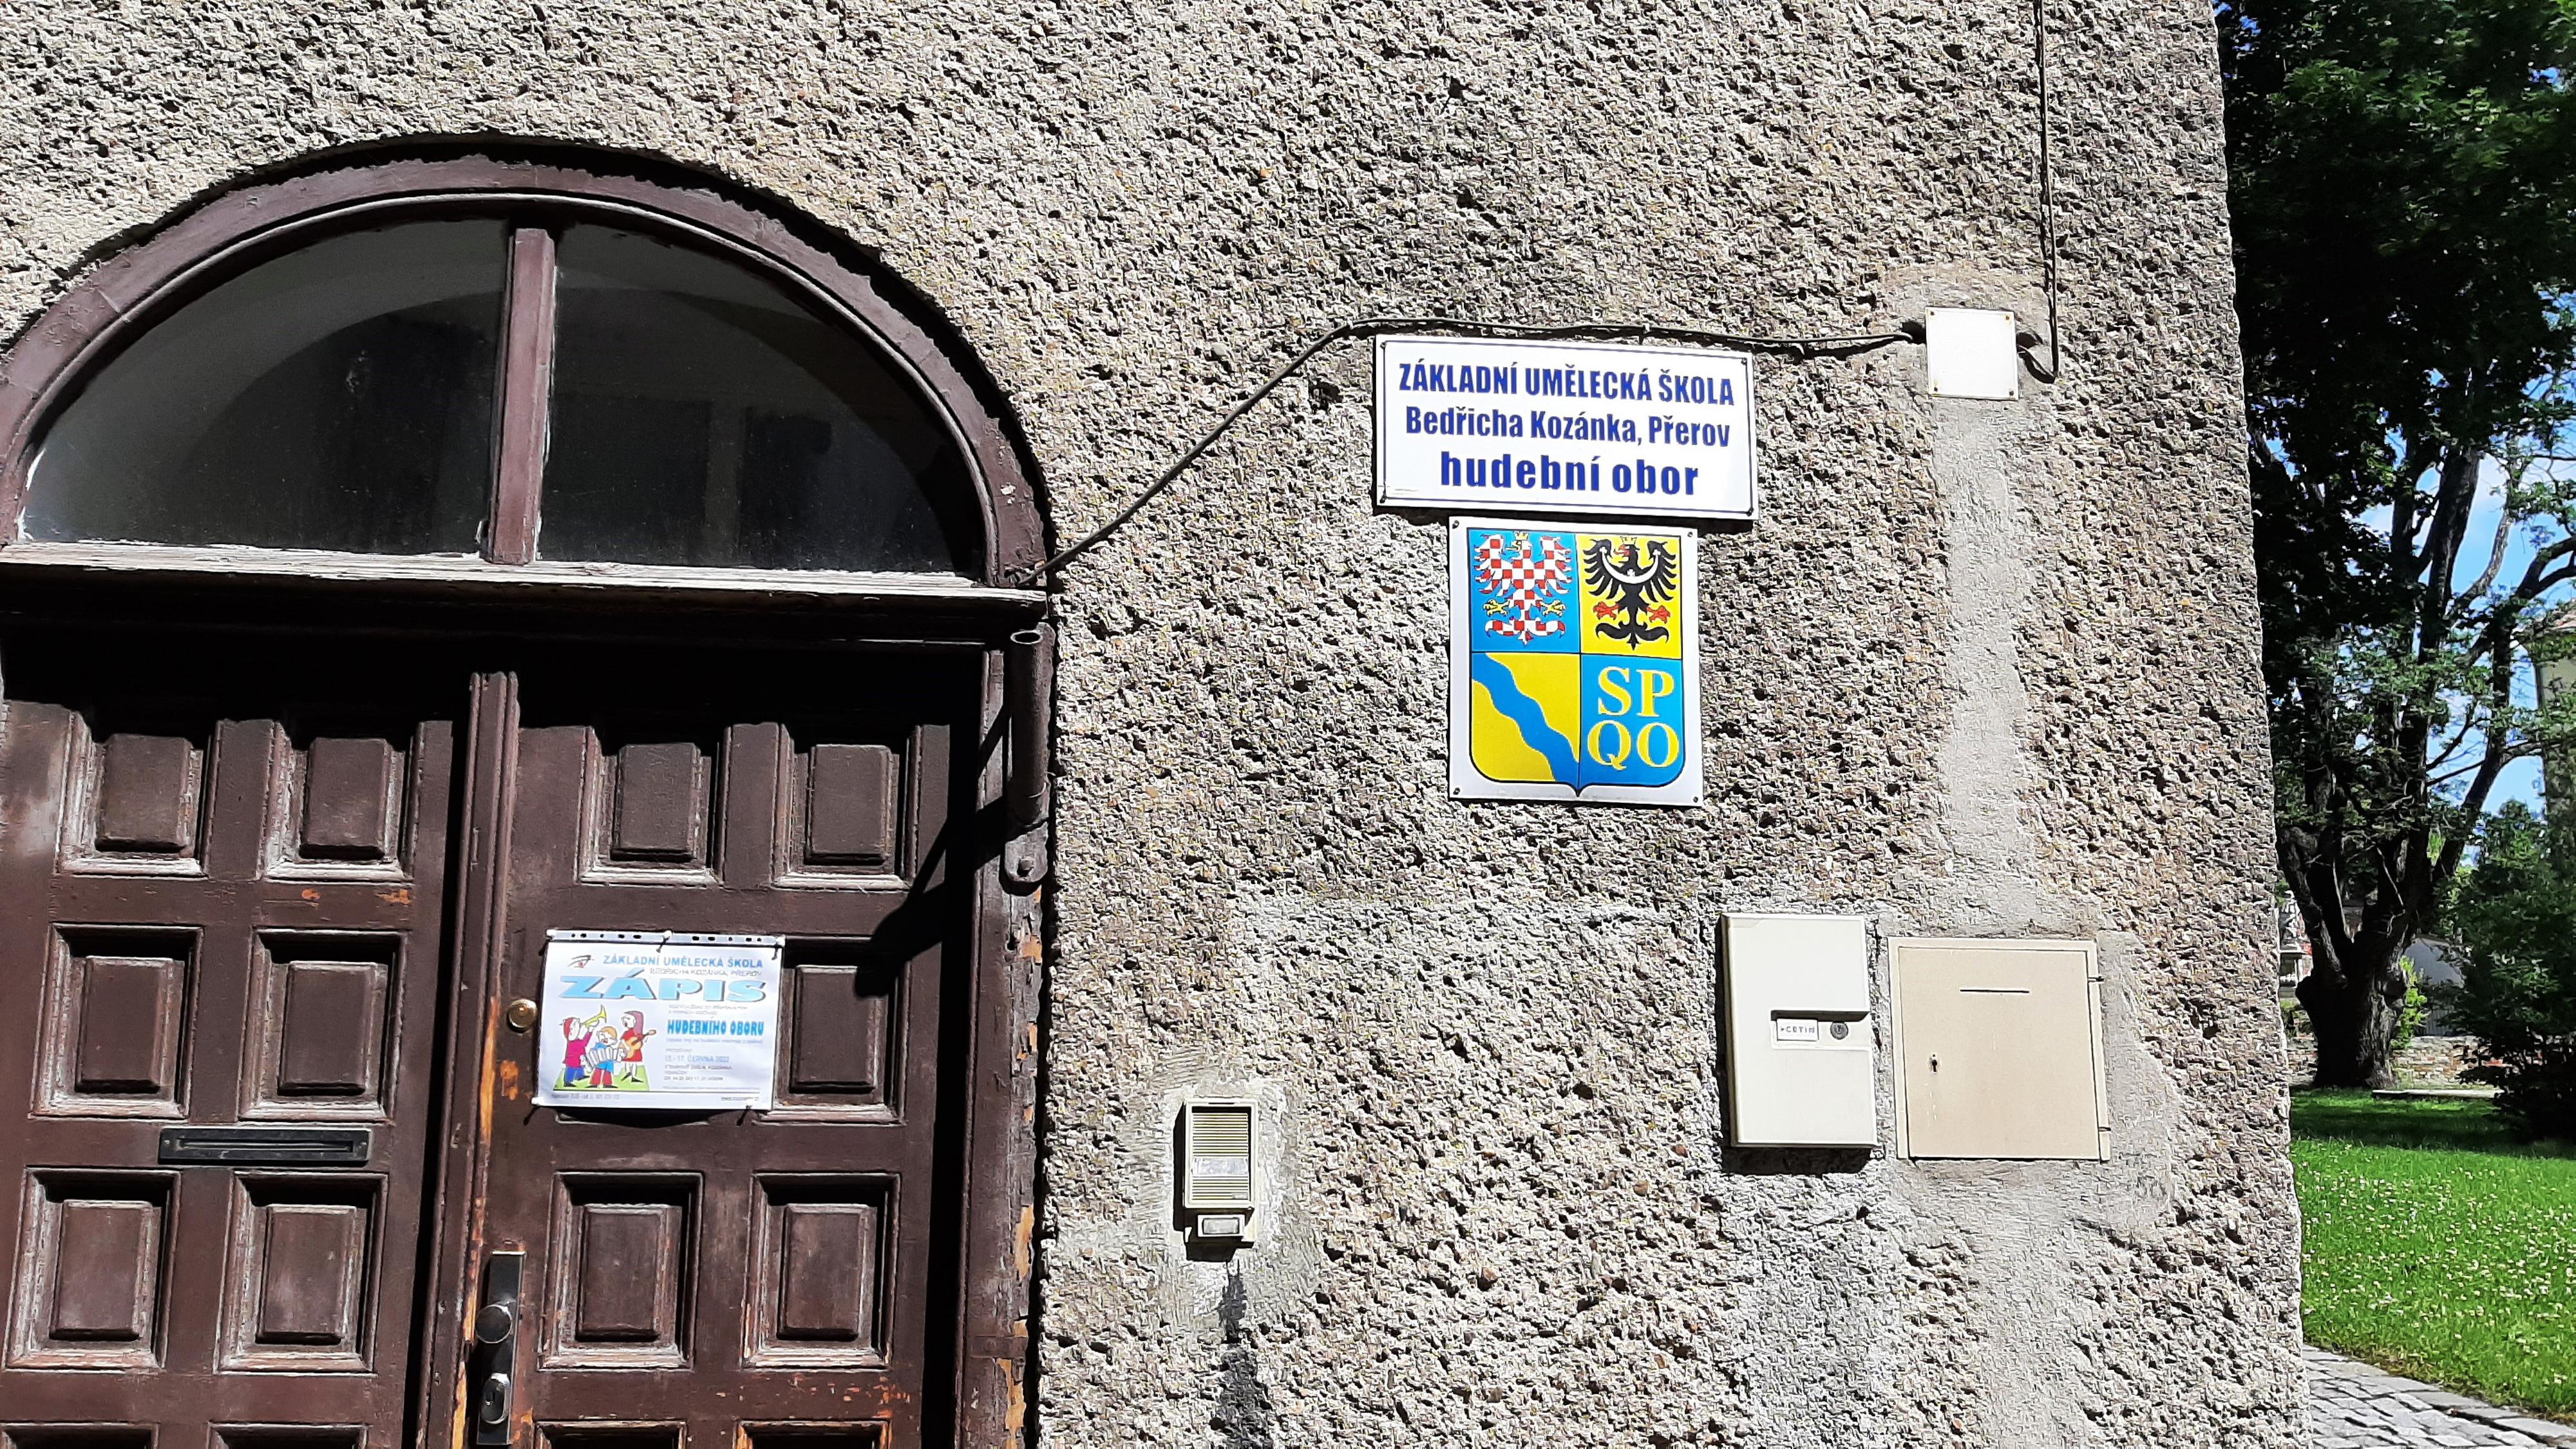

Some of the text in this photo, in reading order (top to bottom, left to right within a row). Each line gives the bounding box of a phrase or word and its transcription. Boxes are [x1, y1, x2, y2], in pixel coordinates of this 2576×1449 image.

[1399, 359, 1734, 406] ZÁKLADNÍ UMĚLECKÁ ŠKOLA
[1406, 406, 1730, 447] Bedřicha Kozánka, Přerov
[1441, 451, 1699, 495] hudební obor
[1598, 666, 1676, 717] SP
[1587, 719, 1680, 770] QO
[603, 954, 762, 968] ZÁKLADNÍ UMĚLECKÁ ŠKOLA
[559, 967, 766, 1002] ZÁPIS
[667, 1017, 764, 1036] HUDEBNÍHO OBORU
